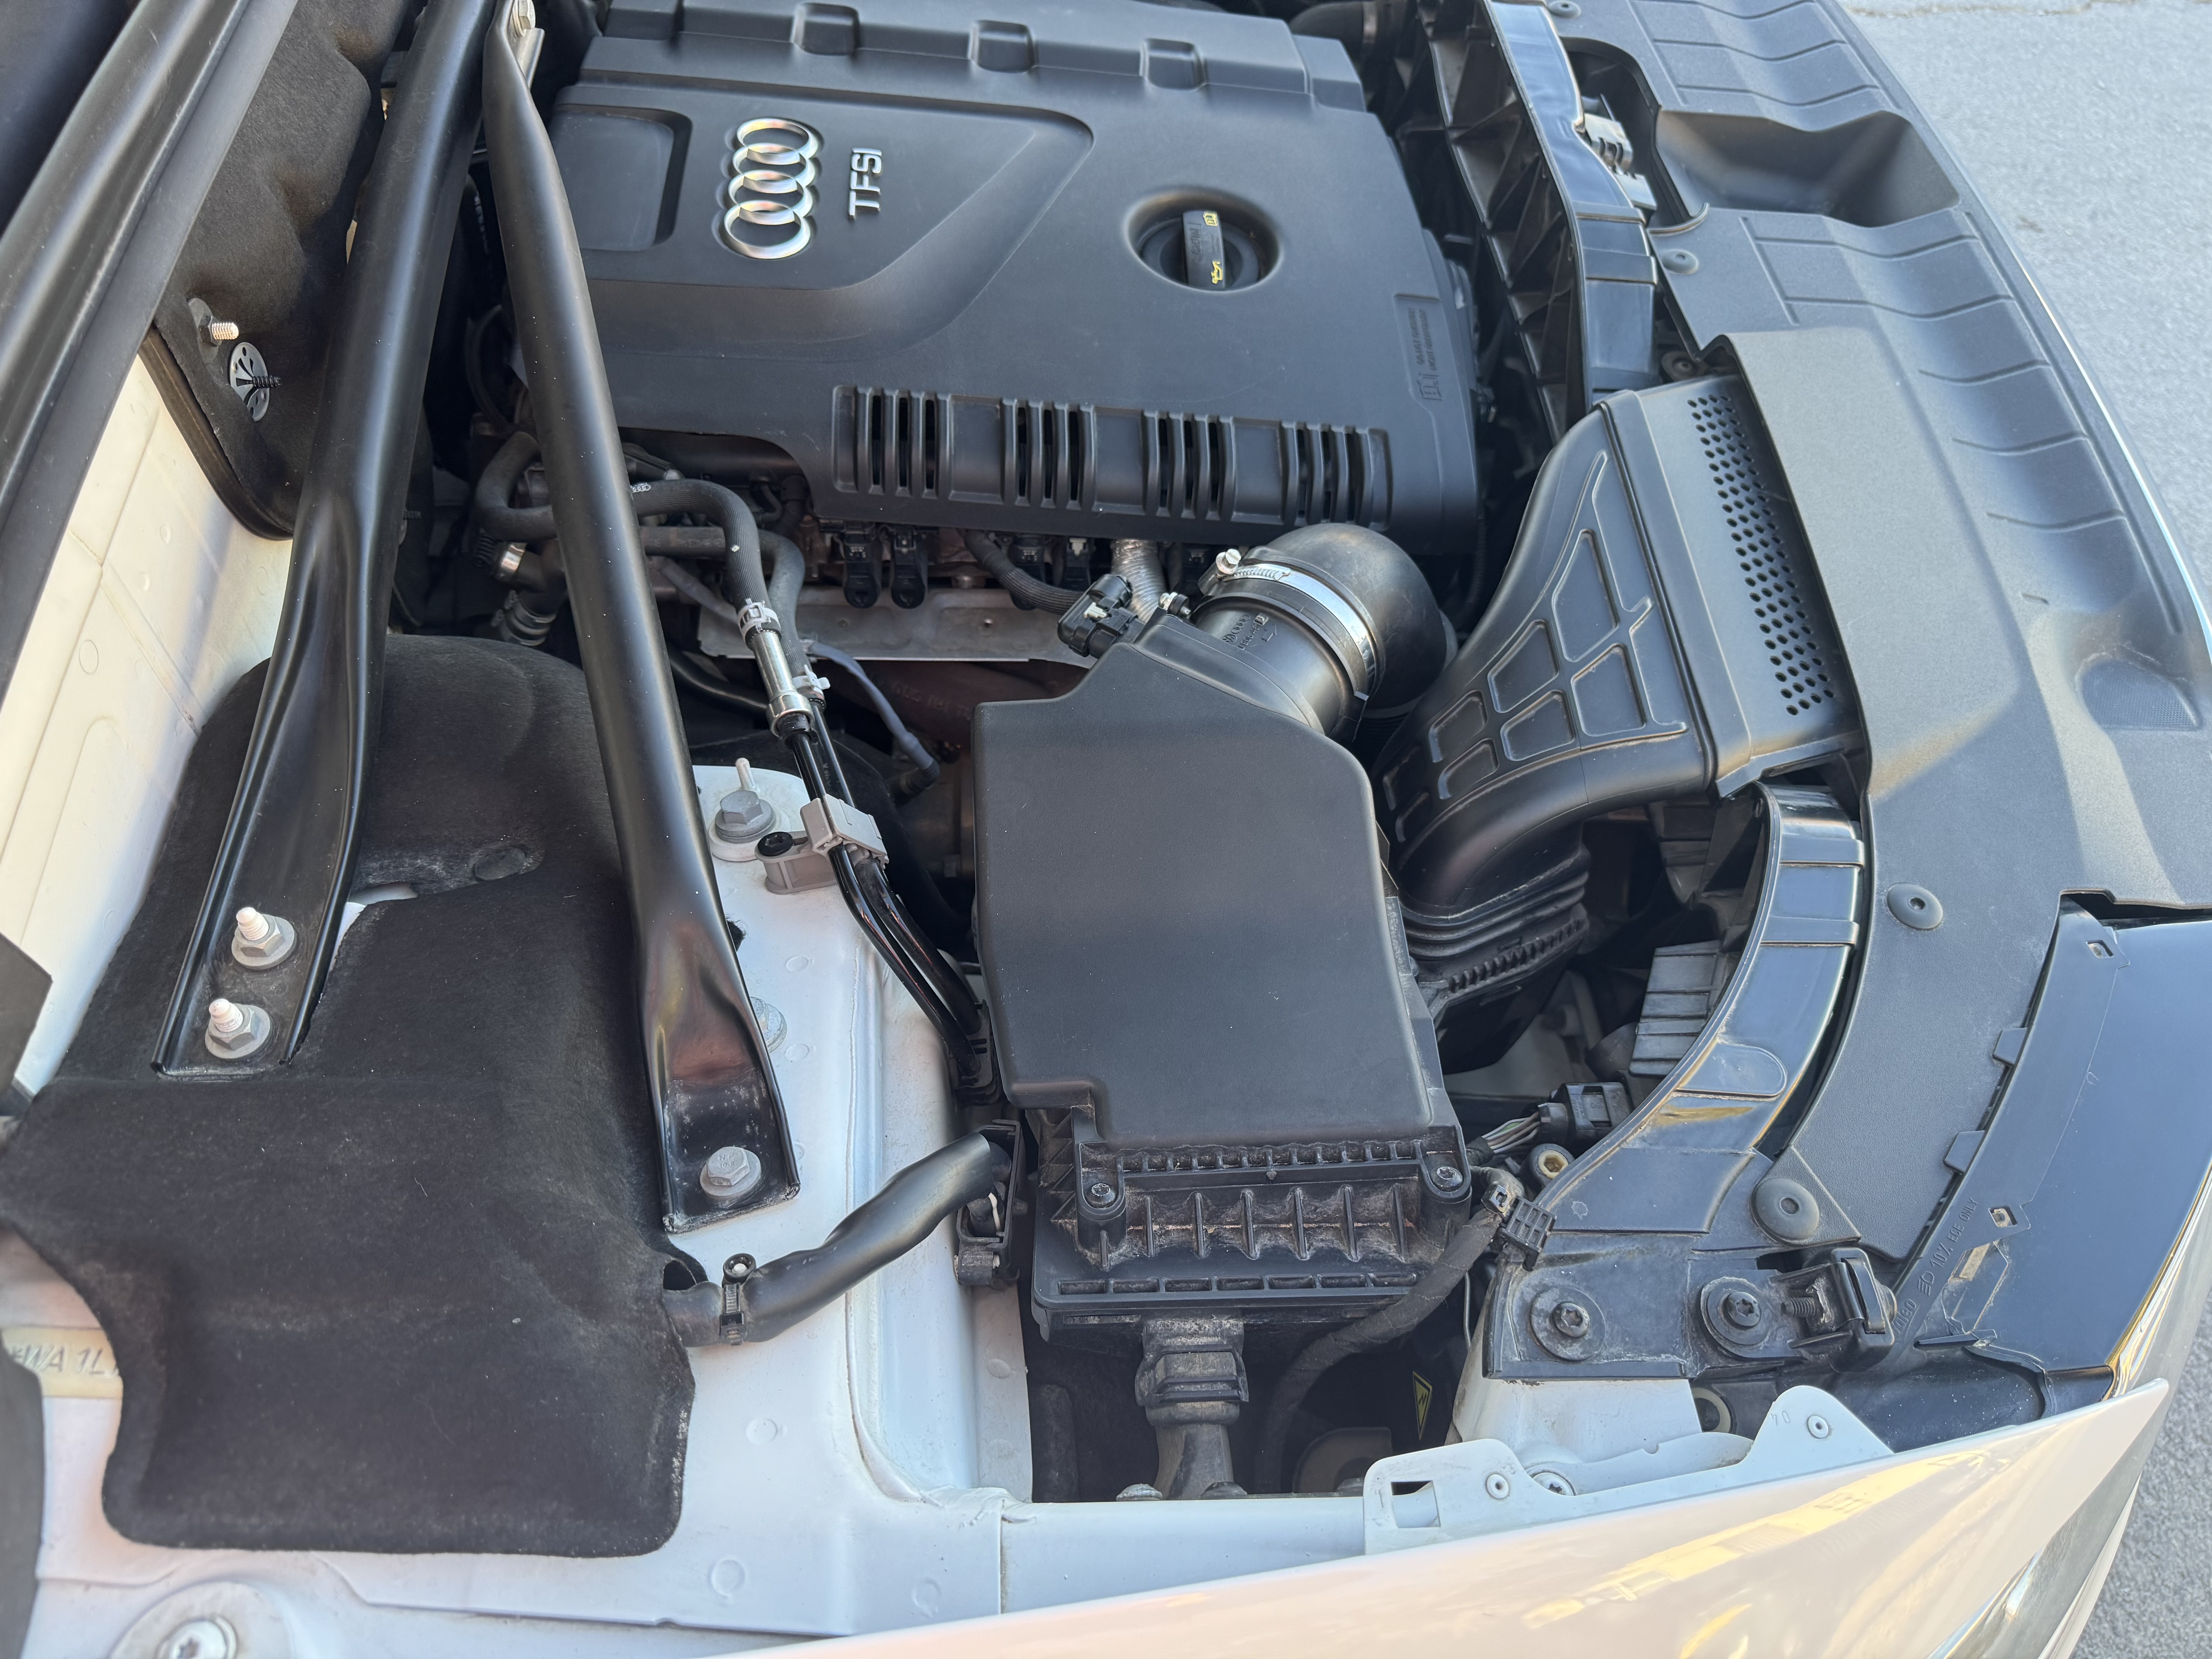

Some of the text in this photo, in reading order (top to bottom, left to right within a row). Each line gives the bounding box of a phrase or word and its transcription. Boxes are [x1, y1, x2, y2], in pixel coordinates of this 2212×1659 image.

[848, 148, 882, 219] TFSI
[1947, 1223, 1964, 1242] ECE
[1959, 1197, 1978, 1221] ONLY
